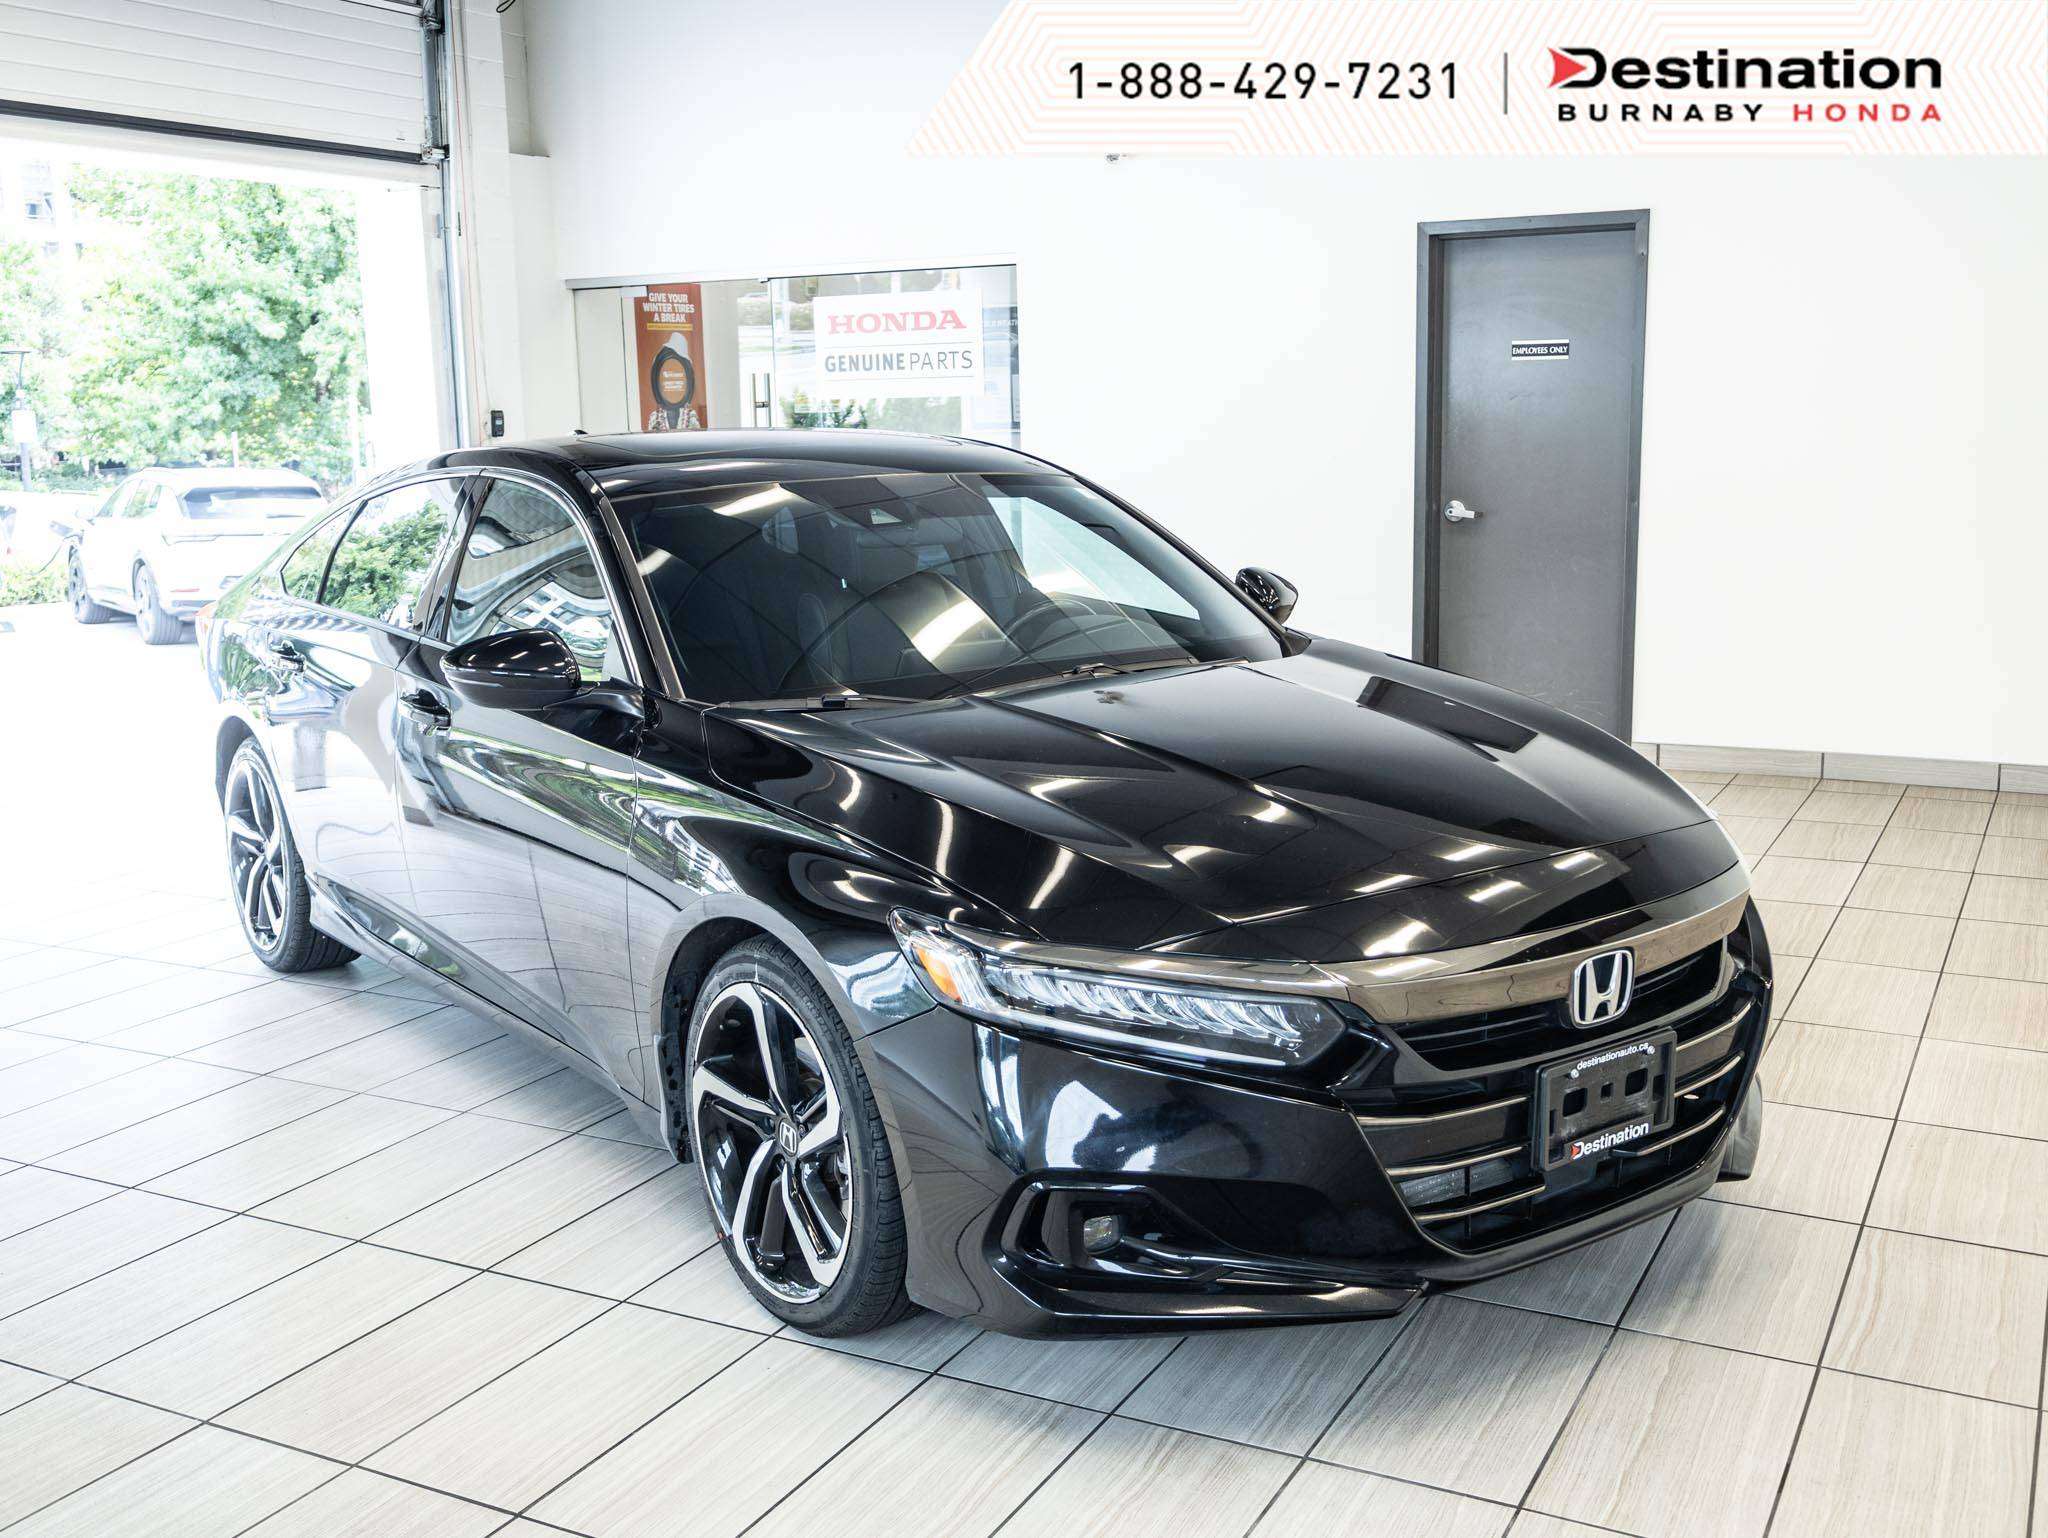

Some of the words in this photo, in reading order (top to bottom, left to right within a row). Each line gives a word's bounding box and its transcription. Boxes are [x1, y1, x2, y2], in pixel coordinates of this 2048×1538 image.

[648, 292, 666, 302] GIVE
[668, 293, 688, 303] YOUR
[643, 302, 672, 312] WINTER
[653, 312, 660, 322] A
[661, 312, 686, 323] BREAK
[828, 309, 966, 335] HONDA
[1512, 347, 1548, 355] EMPLOYEES
[1549, 345, 1568, 353] ONLY
[825, 353, 905, 372] GENUINE
[909, 350, 973, 370] PARTS
[1576, 1042, 1649, 1070] destinationauto.ca
[1571, 1122, 1649, 1160] Destination
